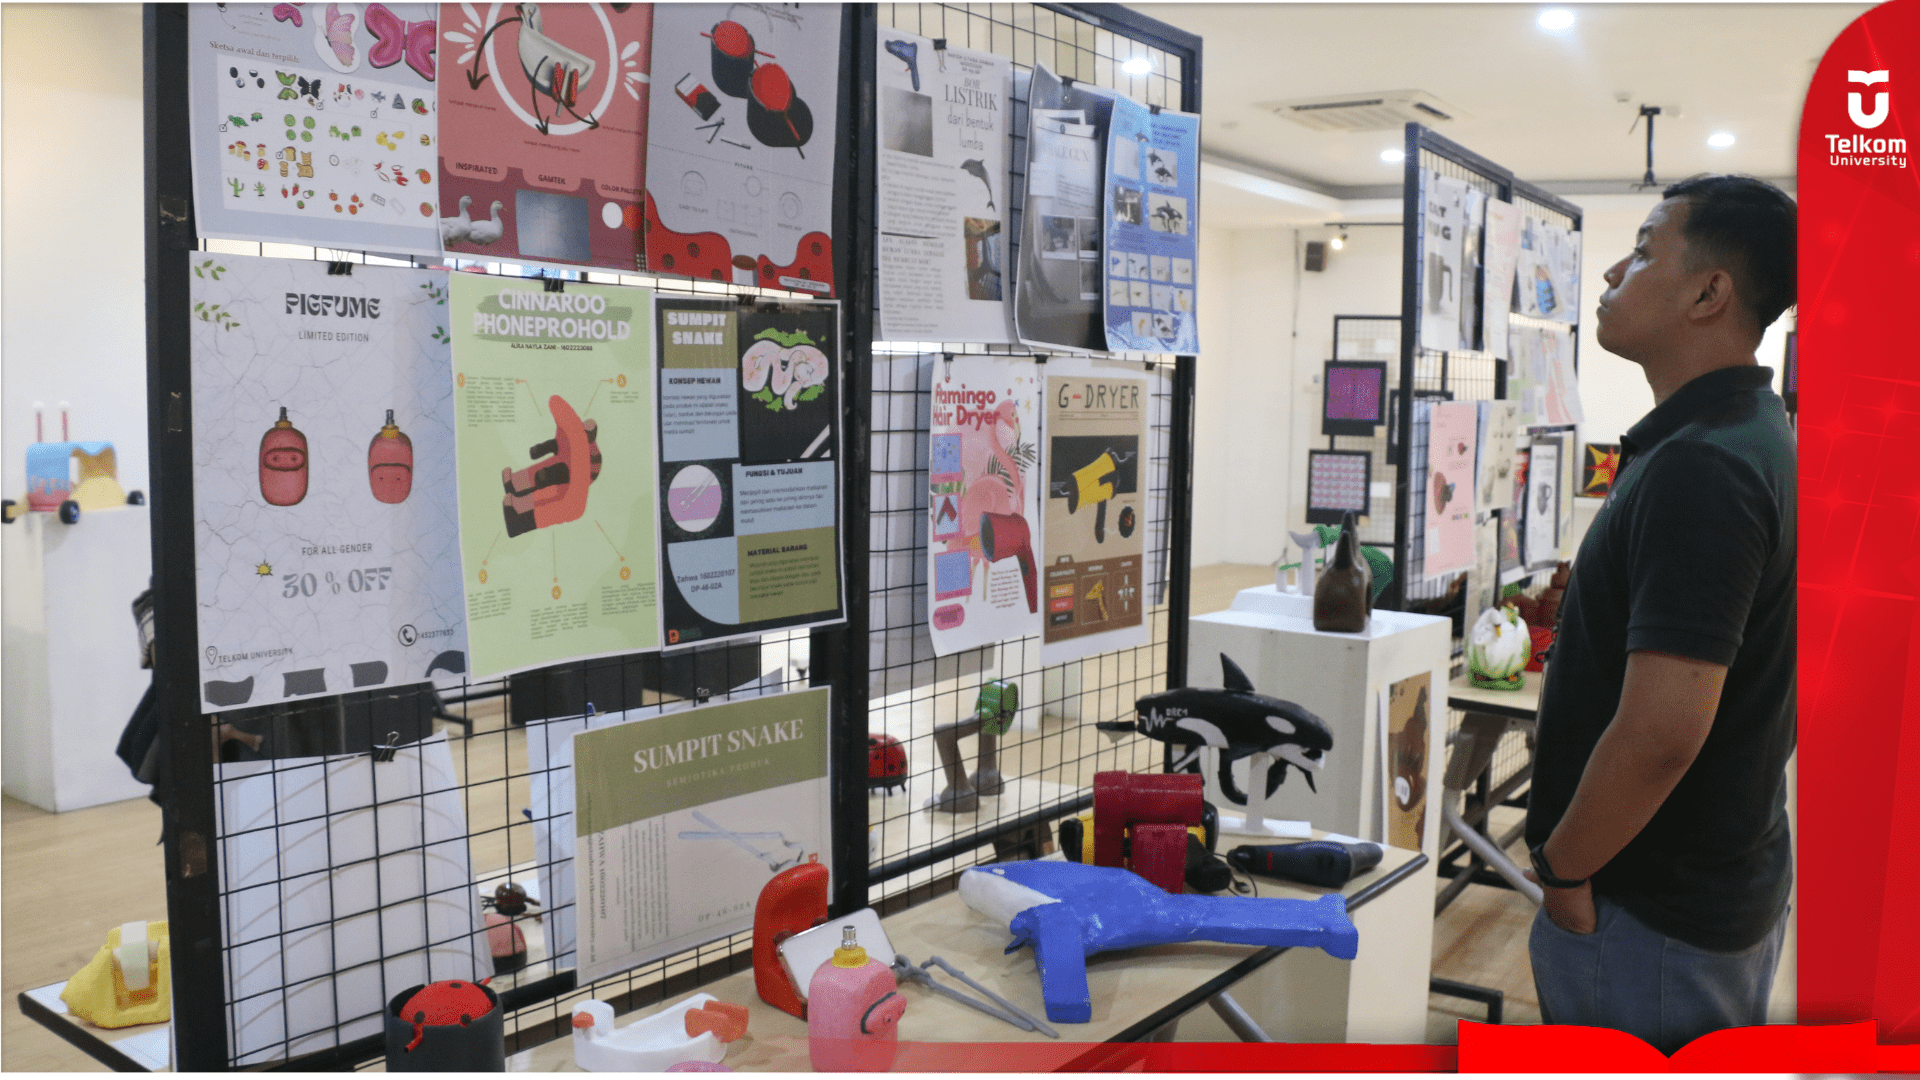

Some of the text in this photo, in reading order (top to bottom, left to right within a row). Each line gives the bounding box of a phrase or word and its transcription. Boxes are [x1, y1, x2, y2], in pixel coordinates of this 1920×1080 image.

[210, 41, 234, 51] Sketsa
[236, 46, 254, 55] awal
[256, 49, 270, 58] dan
[944, 84, 998, 111] LISTRIK
[947, 104, 995, 131] dari bentuk
[959, 128, 984, 151] lumba
[455, 162, 499, 175] INSPIRATED
[285, 292, 381, 319] PIGFUME
[498, 288, 606, 315] CINNAROO
[473, 312, 631, 341] PHONEPROHOLD
[667, 311, 727, 327] SUMPIT
[299, 330, 369, 343] LIMITED EDITION
[672, 331, 723, 345] SNAKE
[956, 405, 1001, 431] Dryer
[302, 543, 373, 556] FOR ALL GENDER
[748, 544, 808, 556] MATERIAL BARANG
[282, 566, 392, 599] 30 % OFF
[677, 575, 698, 583] Zahwa
[218, 647, 293, 663] TELKOM UNIVERSITY
[633, 718, 804, 774] SUMPIT SNAKE
[666, 757, 772, 788] SEMIOTIKA PRODUK
